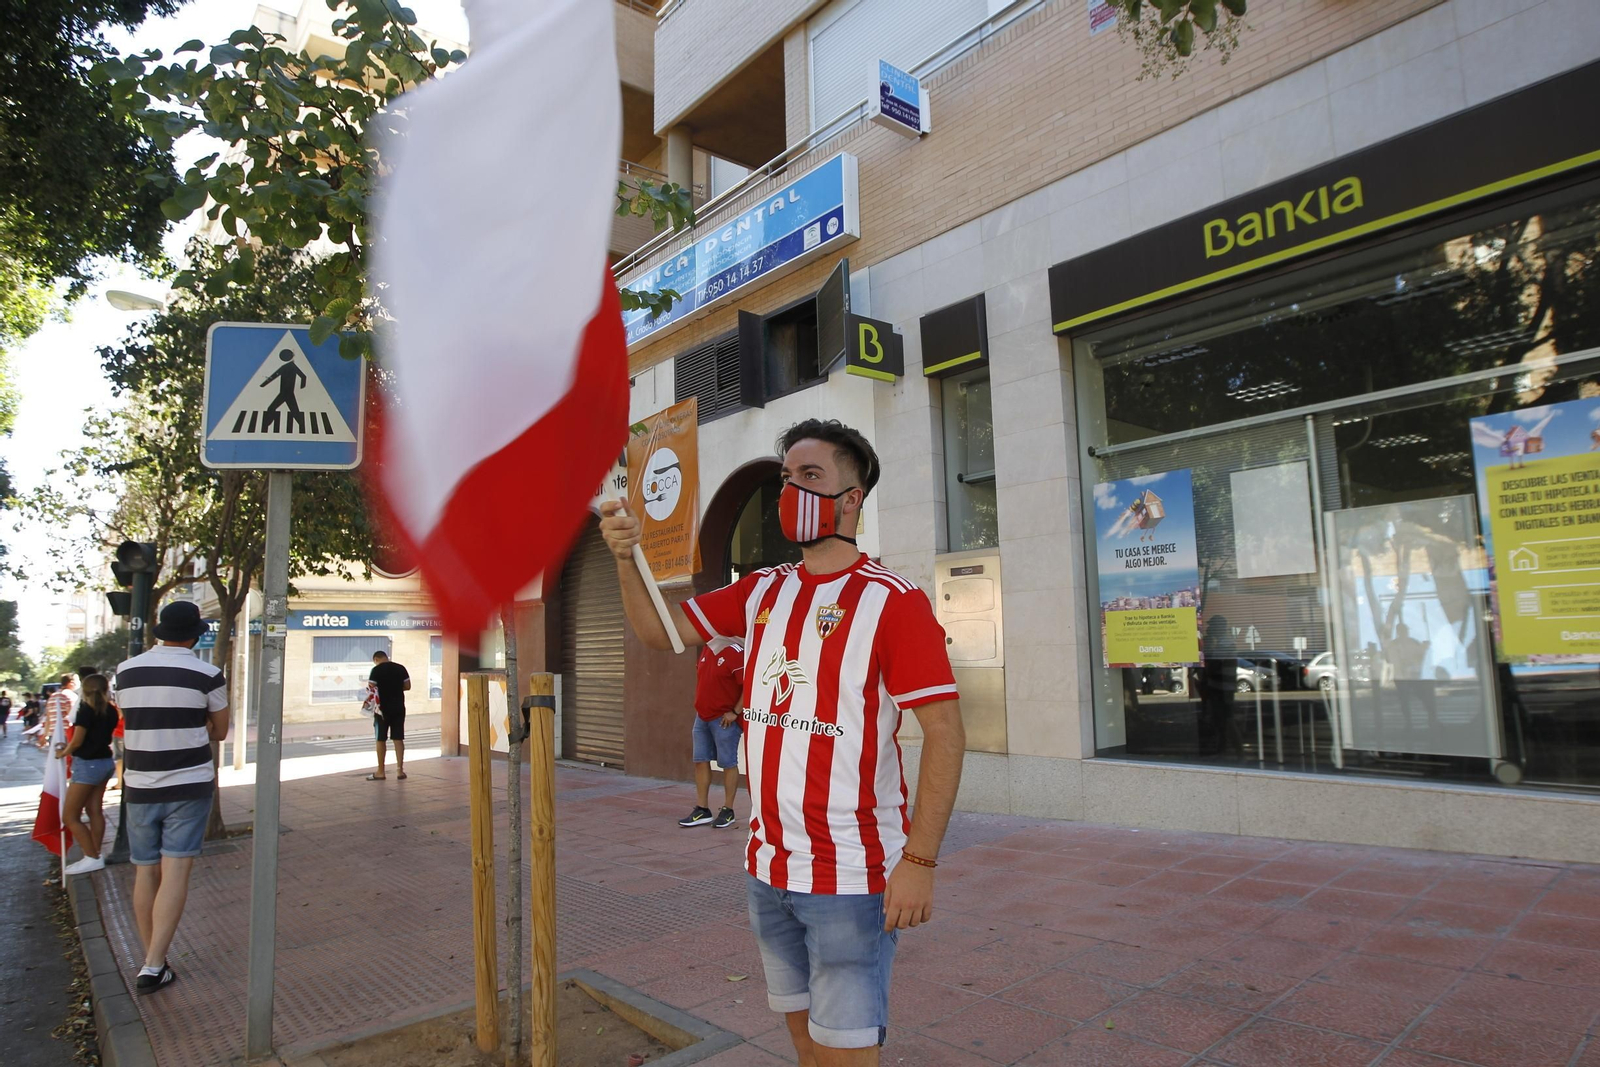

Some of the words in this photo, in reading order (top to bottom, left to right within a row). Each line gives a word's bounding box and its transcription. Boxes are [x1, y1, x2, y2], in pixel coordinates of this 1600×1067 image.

[882, 70, 916, 94] DENTAL
[704, 189, 800, 254] DENTAL
[1203, 176, 1364, 259] Bankia
[726, 272, 738, 287] 14
[752, 257, 764, 274] 37
[859, 323, 884, 364] B
[646, 474, 678, 496] BOCCA
[1502, 476, 1548, 490] DESCUBRE
[1551, 474, 1568, 485] LAS
[1500, 492, 1528, 504] TRAER
[1530, 491, 1542, 500] TU
[1546, 486, 1590, 499] HIPOTECA
[1500, 508, 1518, 518] CON
[1520, 502, 1566, 516] NUESTRAS
[650, 524, 684, 538] RESTAURANTE
[1515, 516, 1559, 530] DIGITALES
[1562, 516, 1575, 526] EN
[650, 538, 670, 549] ABIERTO
[670, 535, 684, 544] PARA
[684, 533, 690, 541] TI
[1115, 549, 1124, 558] TU
[1124, 547, 1142, 558] CASA
[1142, 546, 1150, 556] SE
[1152, 542, 1176, 554] MERECE
[1125, 558, 1142, 568] ALGO
[1143, 556, 1168, 567] MEJOR.
[303, 614, 348, 627] antea
[781, 714, 844, 737] Centres
